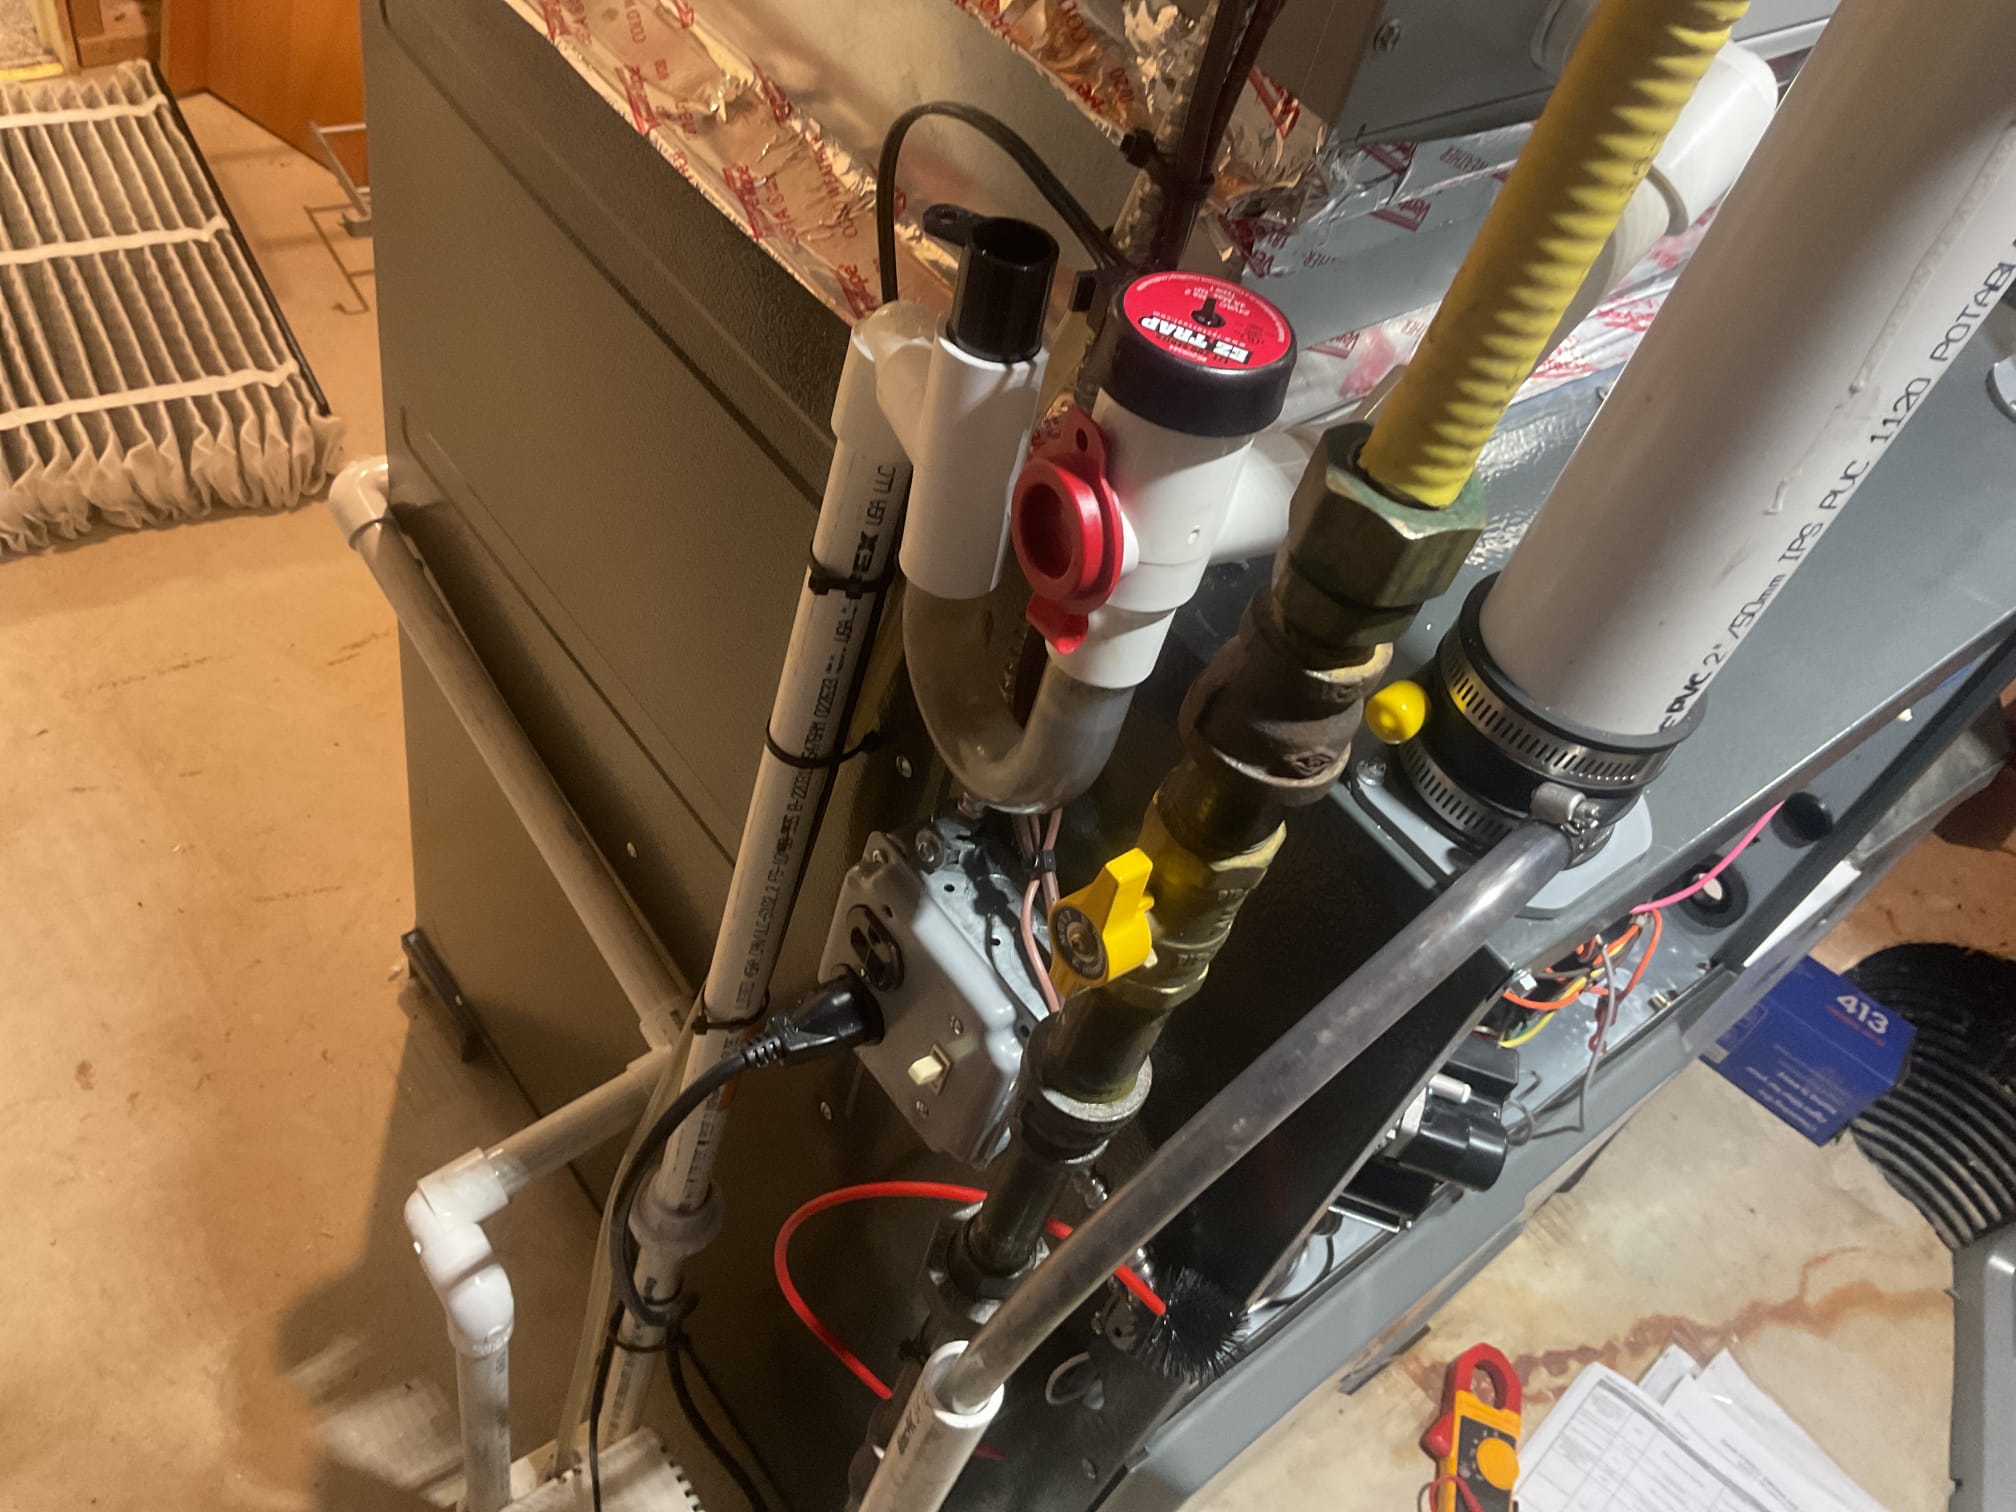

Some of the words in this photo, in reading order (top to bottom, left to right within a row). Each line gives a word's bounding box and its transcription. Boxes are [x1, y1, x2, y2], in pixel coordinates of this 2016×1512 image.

[1139, 315, 1208, 349] TRAP
[1212, 340, 1251, 365] EZ
[873, 464, 897, 495] LLC
[1778, 522, 1824, 563] IPS
[1870, 377, 1931, 444] 1120
[1836, 994, 1889, 1034] 413
